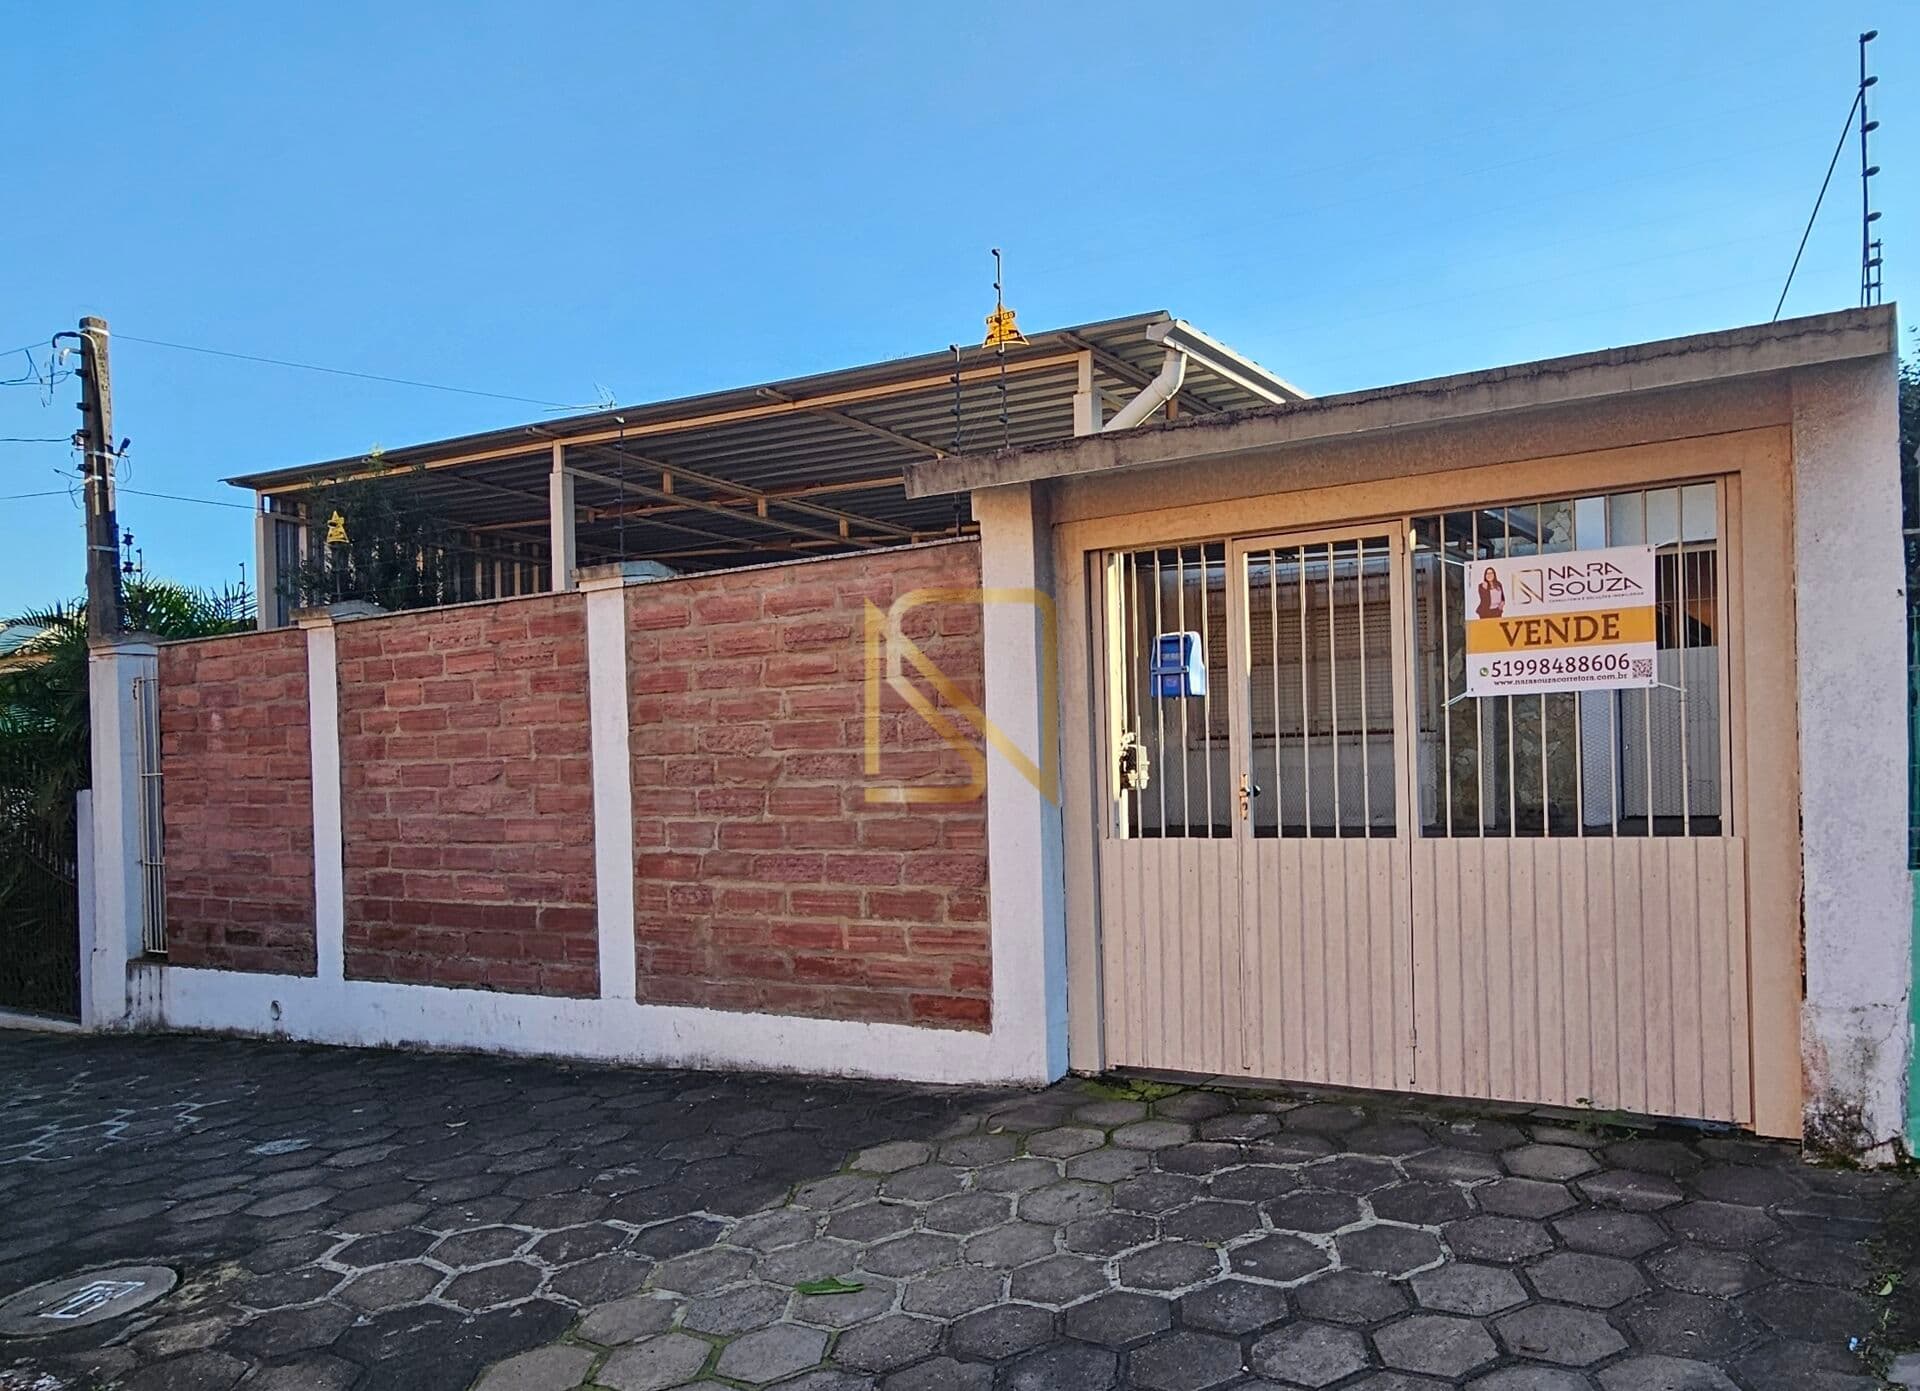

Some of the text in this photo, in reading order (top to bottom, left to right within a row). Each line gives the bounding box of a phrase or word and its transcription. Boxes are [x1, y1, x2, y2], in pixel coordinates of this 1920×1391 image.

[1548, 562, 1623, 580] NARA
[1548, 578, 1643, 597] SOUZA
[1500, 613, 1620, 647] VENDE
[1491, 653, 1630, 678] 51998488606
